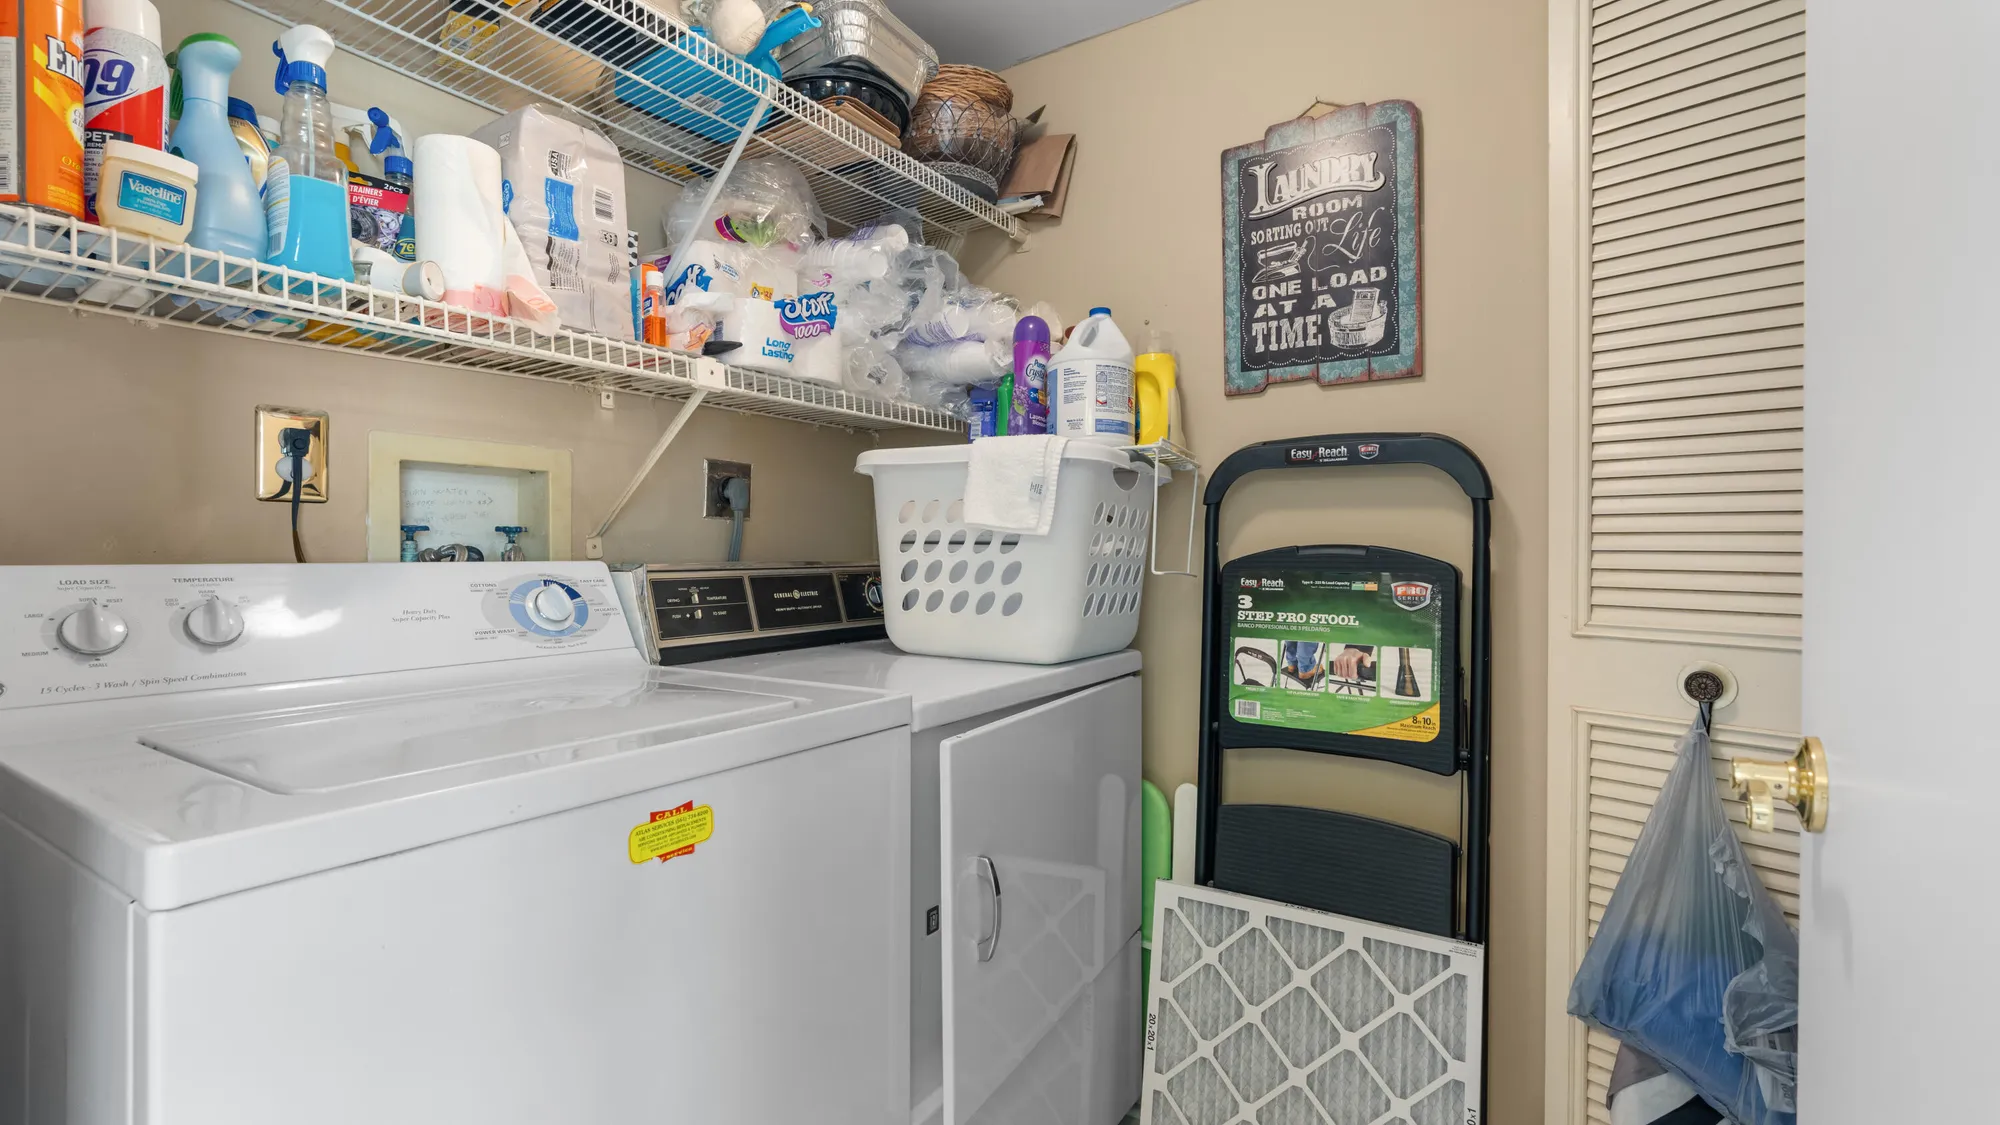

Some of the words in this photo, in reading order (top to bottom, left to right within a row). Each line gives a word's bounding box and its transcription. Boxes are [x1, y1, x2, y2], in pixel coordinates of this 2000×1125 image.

[84, 129, 114, 142] PET
[551, 150, 559, 169] USA
[128, 178, 182, 205] Vaseline
[349, 185, 383, 197] TRAINERS
[1248, 151, 1386, 221] LAUNDRY
[352, 194, 379, 206] D'ÉVIER
[1292, 195, 1363, 221] ROOM
[1250, 223, 1302, 246] SORTING
[1305, 217, 1329, 235] OUT
[1322, 206, 1385, 264] Life
[1252, 280, 1302, 300] ONE
[1312, 266, 1387, 291] LOAD
[785, 292, 835, 321] Scott
[1253, 300, 1297, 318] AT
[1311, 294, 1337, 310] A
[794, 323, 821, 339] 1000
[1252, 314, 1322, 353] TIME
[766, 337, 791, 350] Long
[762, 347, 795, 363] Lasting
[1291, 448, 1312, 460] Easy
[1318, 446, 1347, 458] Reach
[1240, 577, 1258, 588] Easy
[1261, 578, 1284, 587] Reach
[1396, 586, 1426, 596] PRO
[1237, 595, 1253, 609] 3
[410, 615, 437, 623] Capacity
[1237, 610, 1274, 622] STEP
[1276, 612, 1307, 624] PRO
[1309, 613, 1359, 626] STOOL
[40, 686, 52, 695] 15
[55, 683, 86, 695] Cycles
[103, 679, 129, 689] Wash
[140, 676, 161, 688] Spin
[162, 674, 188, 686] Speed
[189, 671, 247, 682] Combinations
[656, 807, 687, 821] CALL
[652, 820, 675, 831] SERVICES
